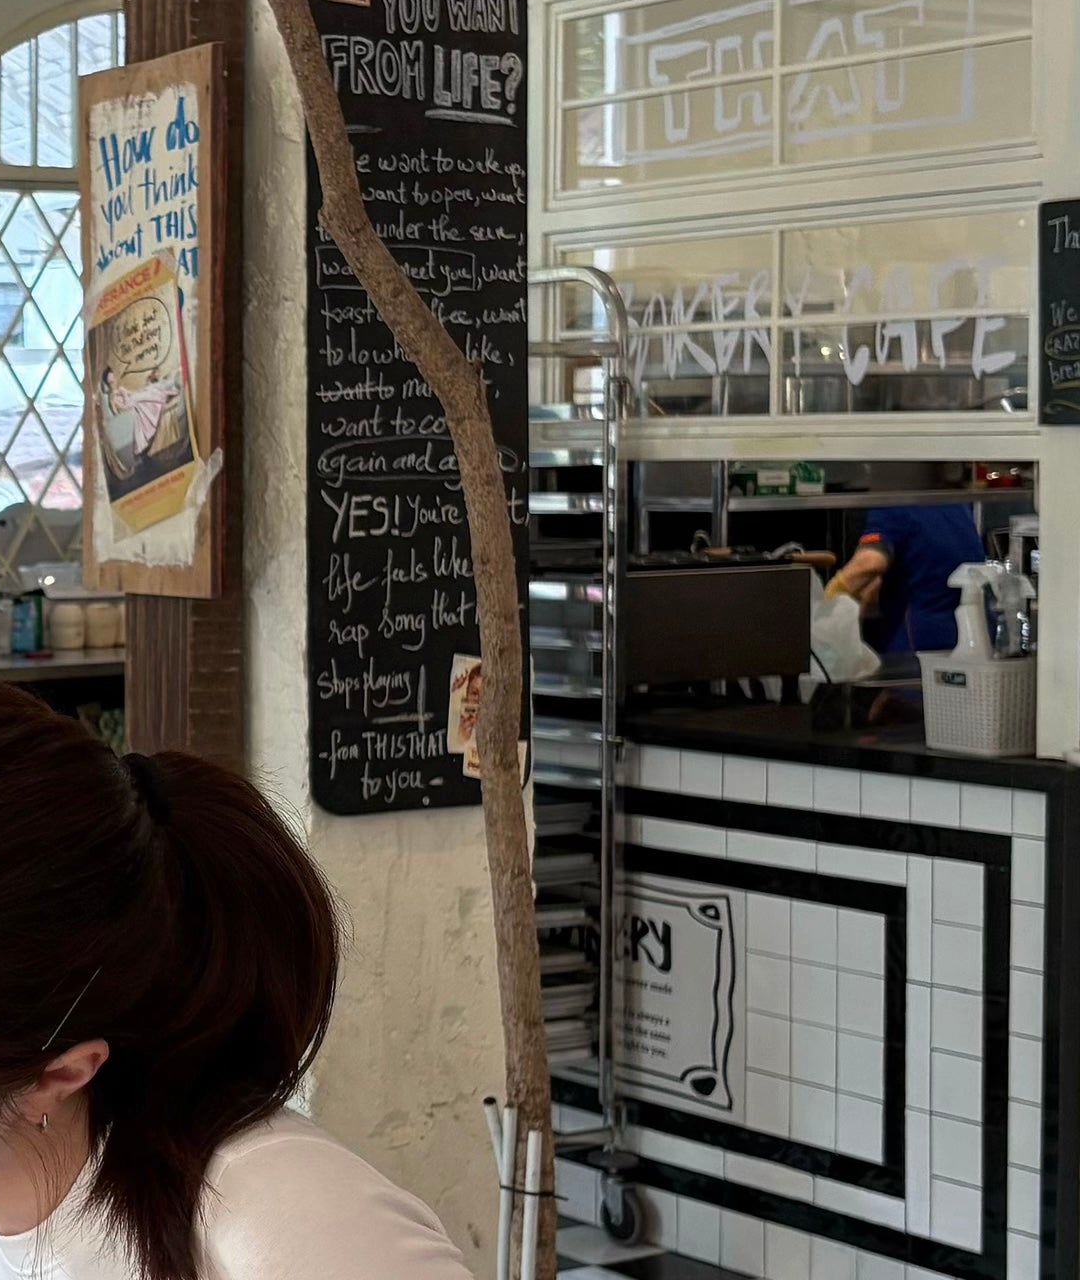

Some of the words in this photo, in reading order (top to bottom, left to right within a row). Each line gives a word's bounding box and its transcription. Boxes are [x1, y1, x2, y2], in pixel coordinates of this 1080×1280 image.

[321, 35, 426, 101] FROM
[432, 44, 523, 116] LIFE?
[97, 126, 156, 192] How
[166, 96, 200, 151] do
[378, 147, 431, 174] want
[432, 147, 454, 174] to
[457, 147, 504, 174] wake
[101, 192, 134, 242] you
[137, 154, 199, 212] think
[412, 181, 430, 206] to
[481, 186, 526, 205] want
[375, 210, 425, 240] under
[427, 213, 465, 242] the
[176, 247, 200, 278] AT
[482, 256, 527, 284] want
[483, 297, 526, 324] want
[320, 335, 344, 366] to
[321, 404, 384, 437] want
[391, 406, 415, 436] to
[317, 451, 386, 488] again
[392, 441, 437, 473] and
[320, 489, 400, 544] YES!
[323, 553, 377, 614] life
[381, 548, 428, 607] feels
[433, 536, 474, 579] like
[328, 620, 369, 659] rap
[378, 607, 426, 651] song
[431, 589, 474, 630] that
[360, 761, 383, 800] to
